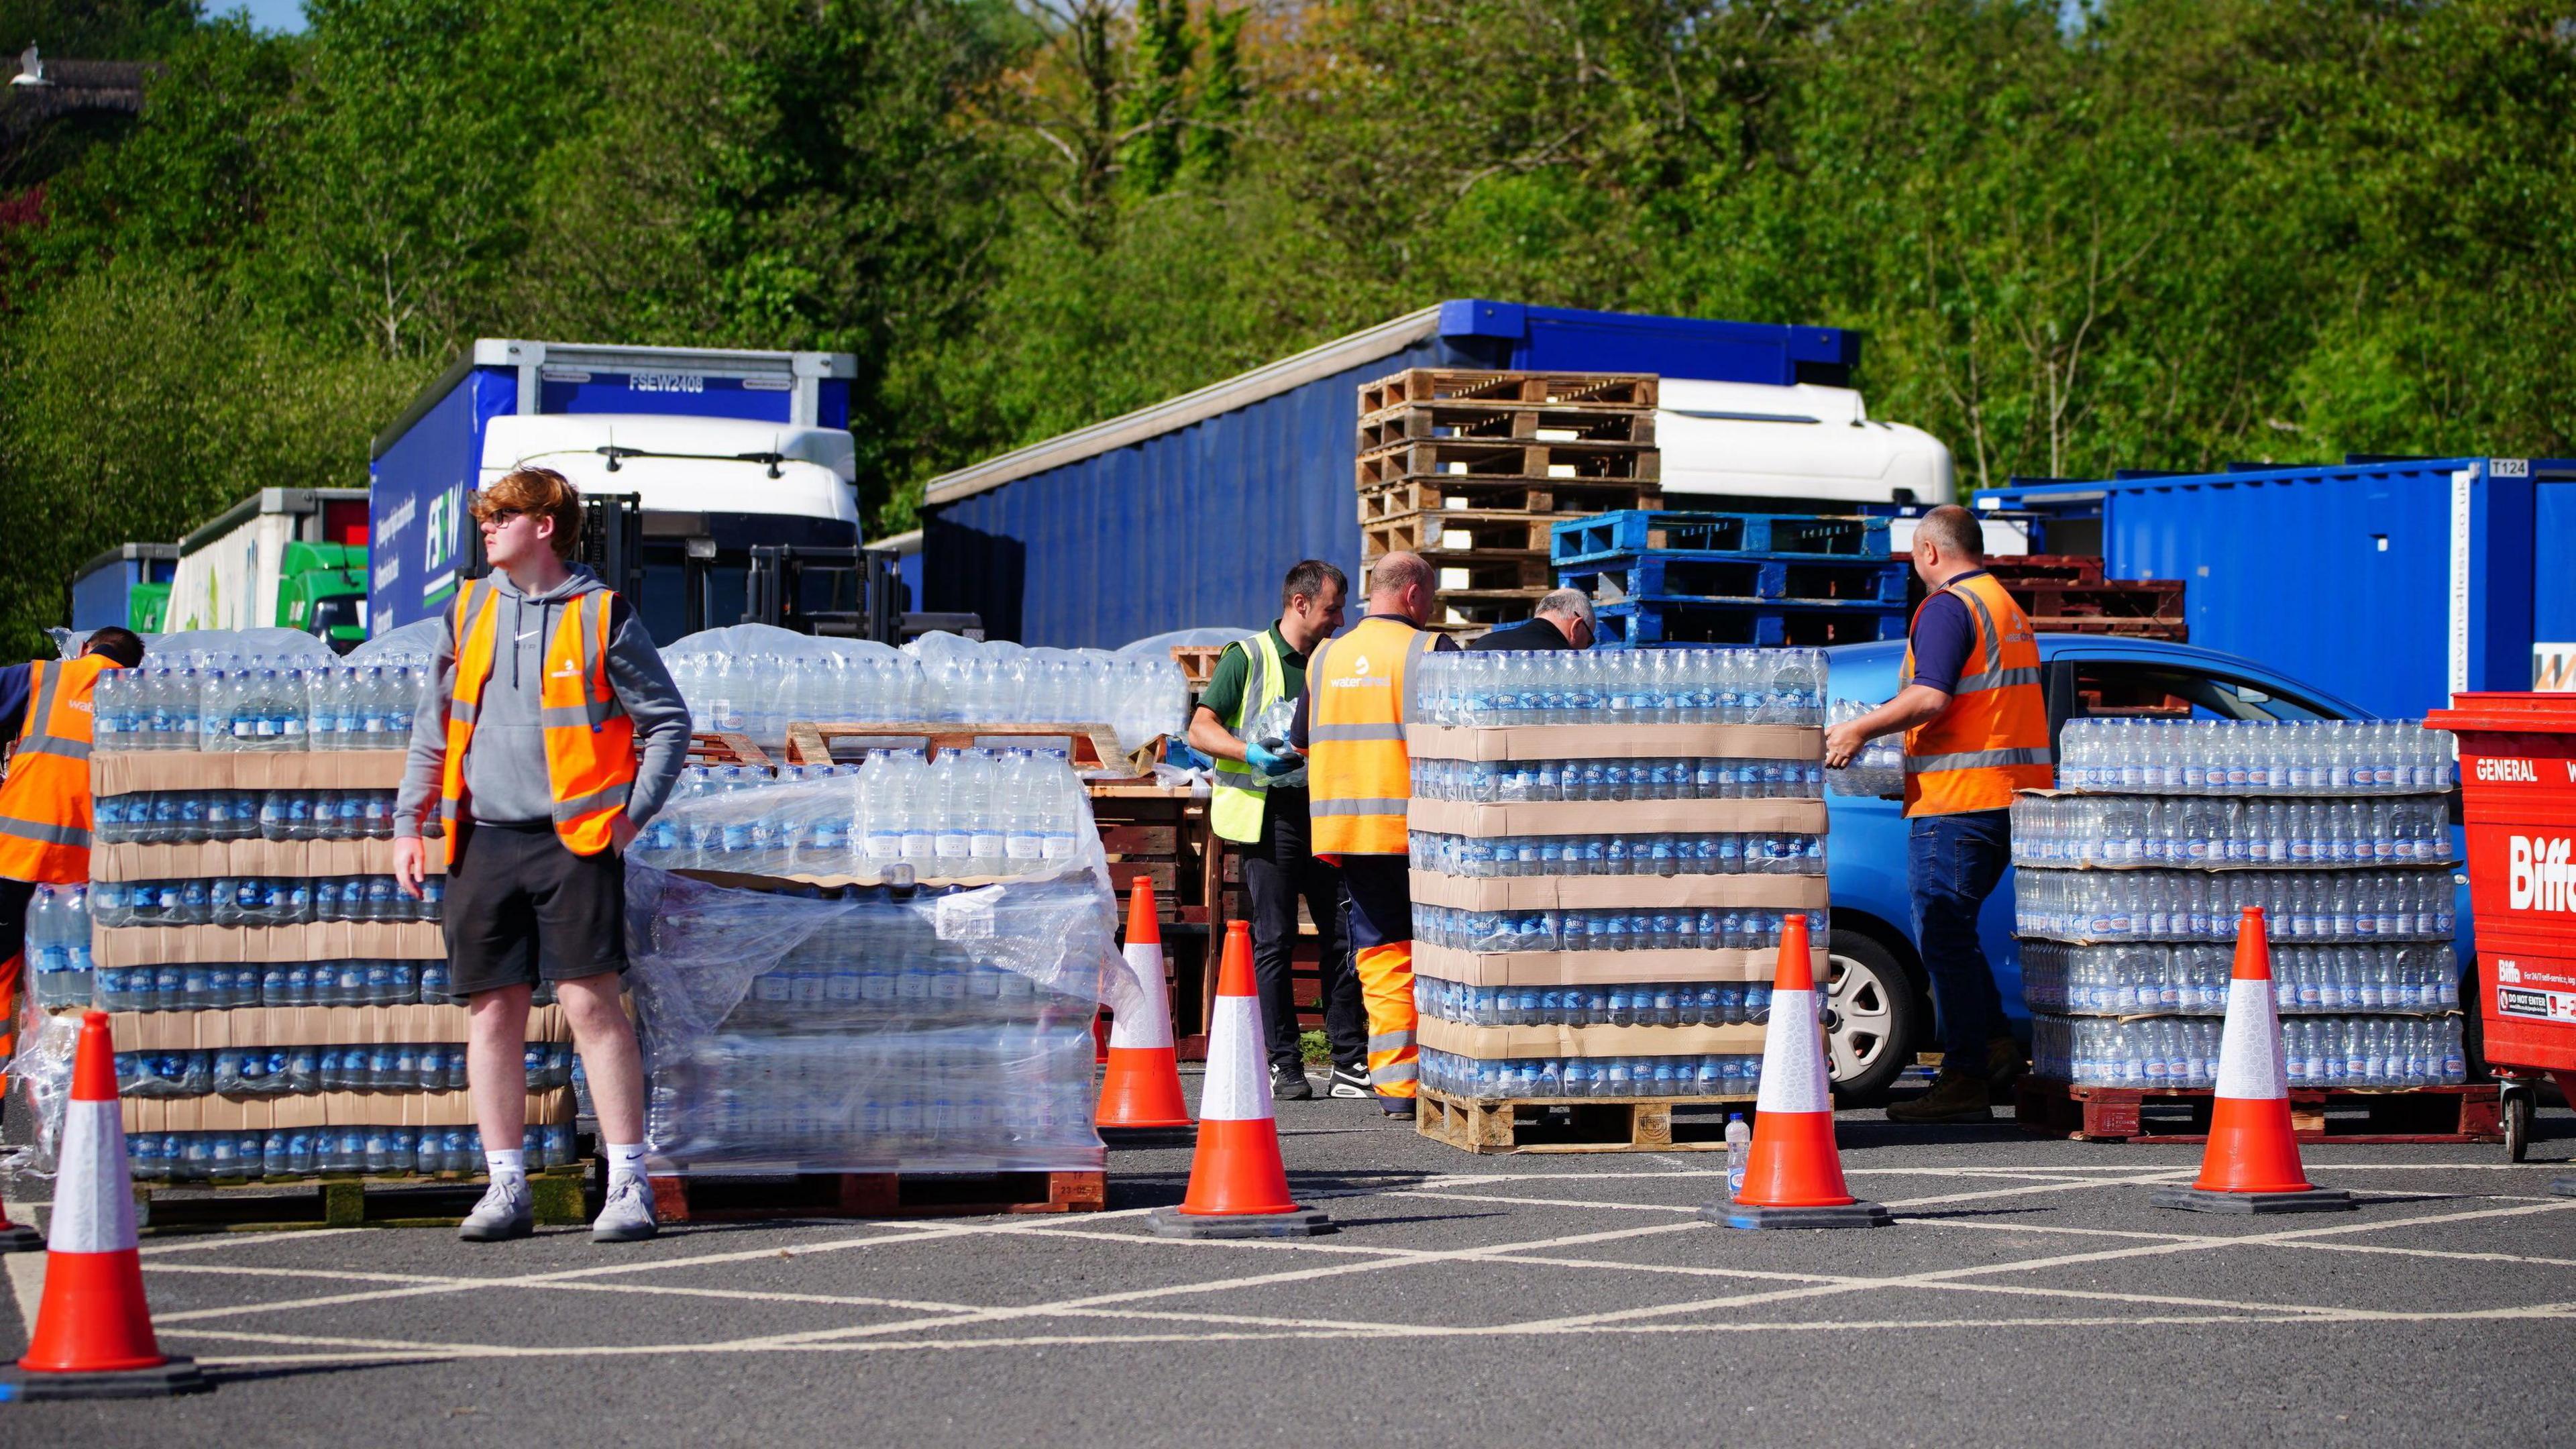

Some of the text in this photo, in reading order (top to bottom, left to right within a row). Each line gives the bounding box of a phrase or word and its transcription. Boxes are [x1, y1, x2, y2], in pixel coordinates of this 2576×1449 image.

[629, 374, 703, 392] FSEW2408
[2492, 462, 2526, 474] T124
[425, 479, 464, 573] FSEW
[2455, 480, 2467, 692] arevans4less.co.uk
[2477, 759, 2538, 782] GENERAL
[2499, 960, 2520, 983] Biffa
[2509, 994, 2546, 1006] DO NOT ENTER
